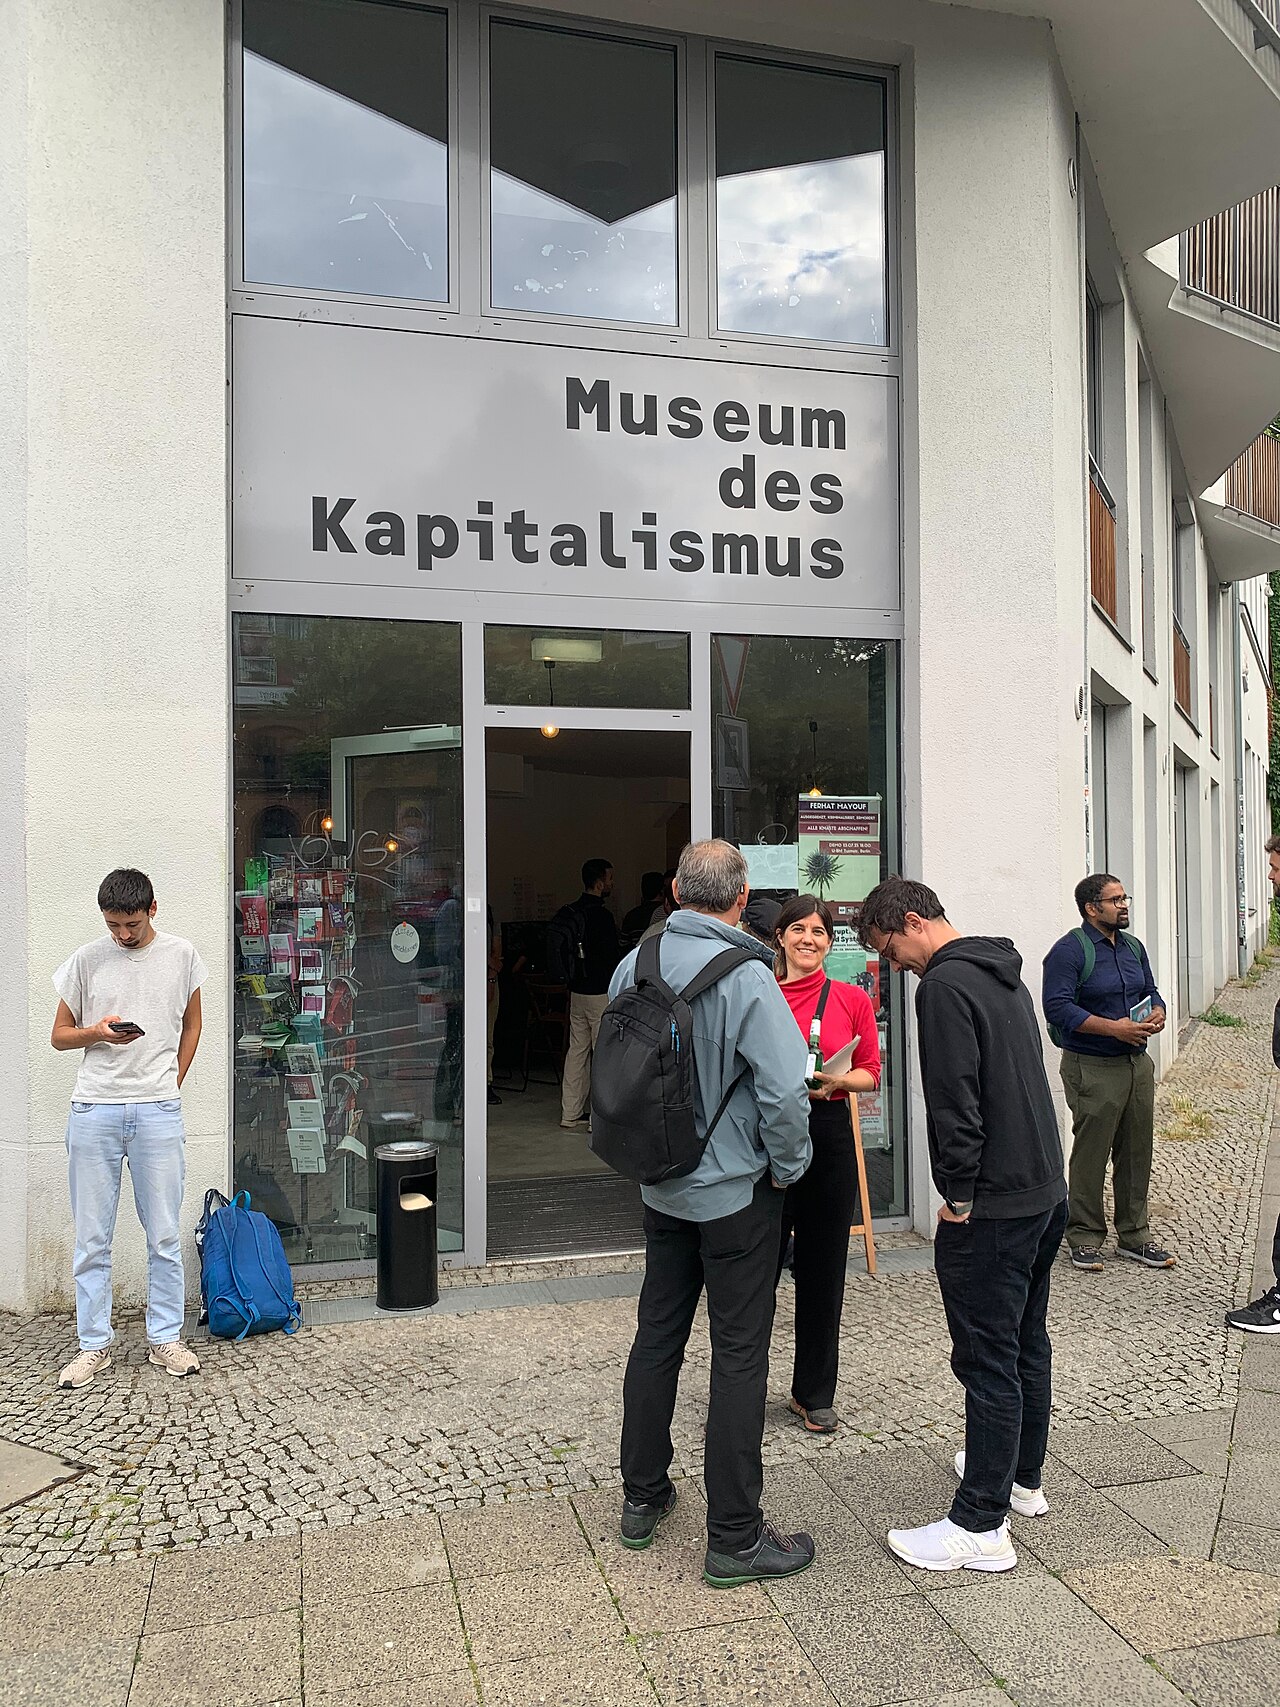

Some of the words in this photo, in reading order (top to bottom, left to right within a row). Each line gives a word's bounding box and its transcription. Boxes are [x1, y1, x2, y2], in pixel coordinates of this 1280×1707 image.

[565, 377, 846, 450] Museum
[718, 454, 844, 514] des
[311, 496, 844, 580] Kapitalismus
[841, 936, 857, 944] Syst
